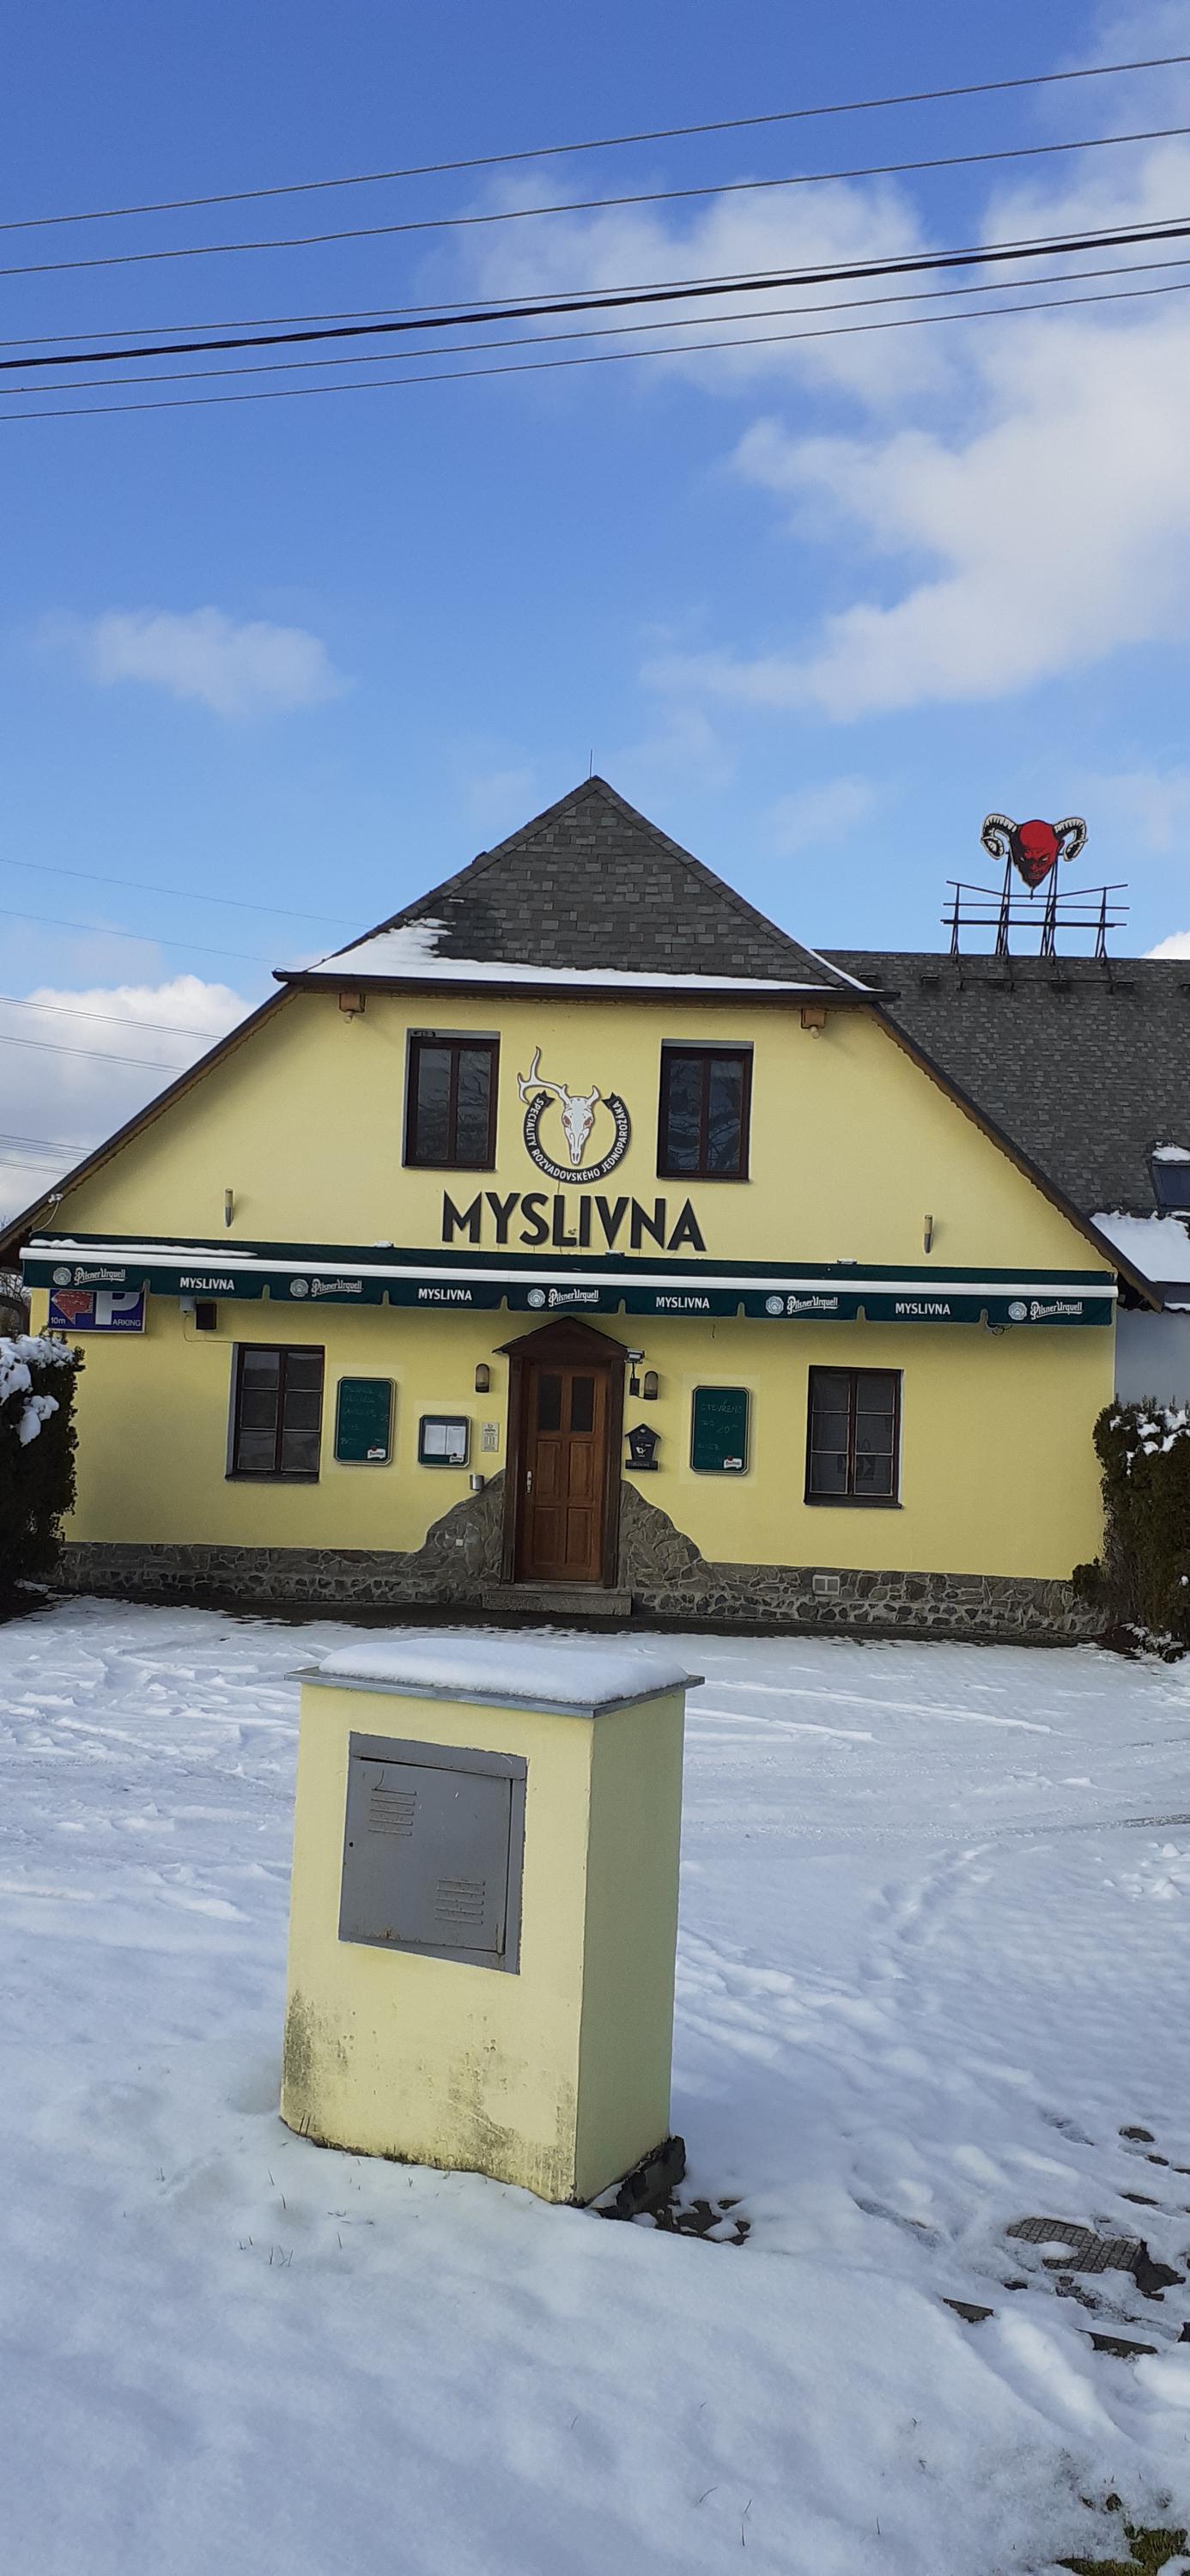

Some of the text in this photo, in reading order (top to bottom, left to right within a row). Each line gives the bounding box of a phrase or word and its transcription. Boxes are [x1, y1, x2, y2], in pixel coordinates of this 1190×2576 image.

[525, 1097, 628, 1182] SPECIALITY ROZVADOVSKÉHO JEDNOPAROŽÁKA
[441, 1189, 707, 1252] MYSLIVNA
[74, 1267, 126, 1286] Pilsner Urquell
[179, 1277, 234, 1291] MYSLIVNA
[311, 1278, 362, 1297] Pilsner Urquell
[418, 1288, 472, 1301] MYSLIVNA
[548, 1288, 599, 1308] Pilsner Urquell
[655, 1297, 710, 1309] MYSLIVNA
[786, 1295, 839, 1315] Pilsner Urquell
[895, 1303, 951, 1315] MYSLIVNA
[1029, 1300, 1083, 1321] Pilsner Urquell
